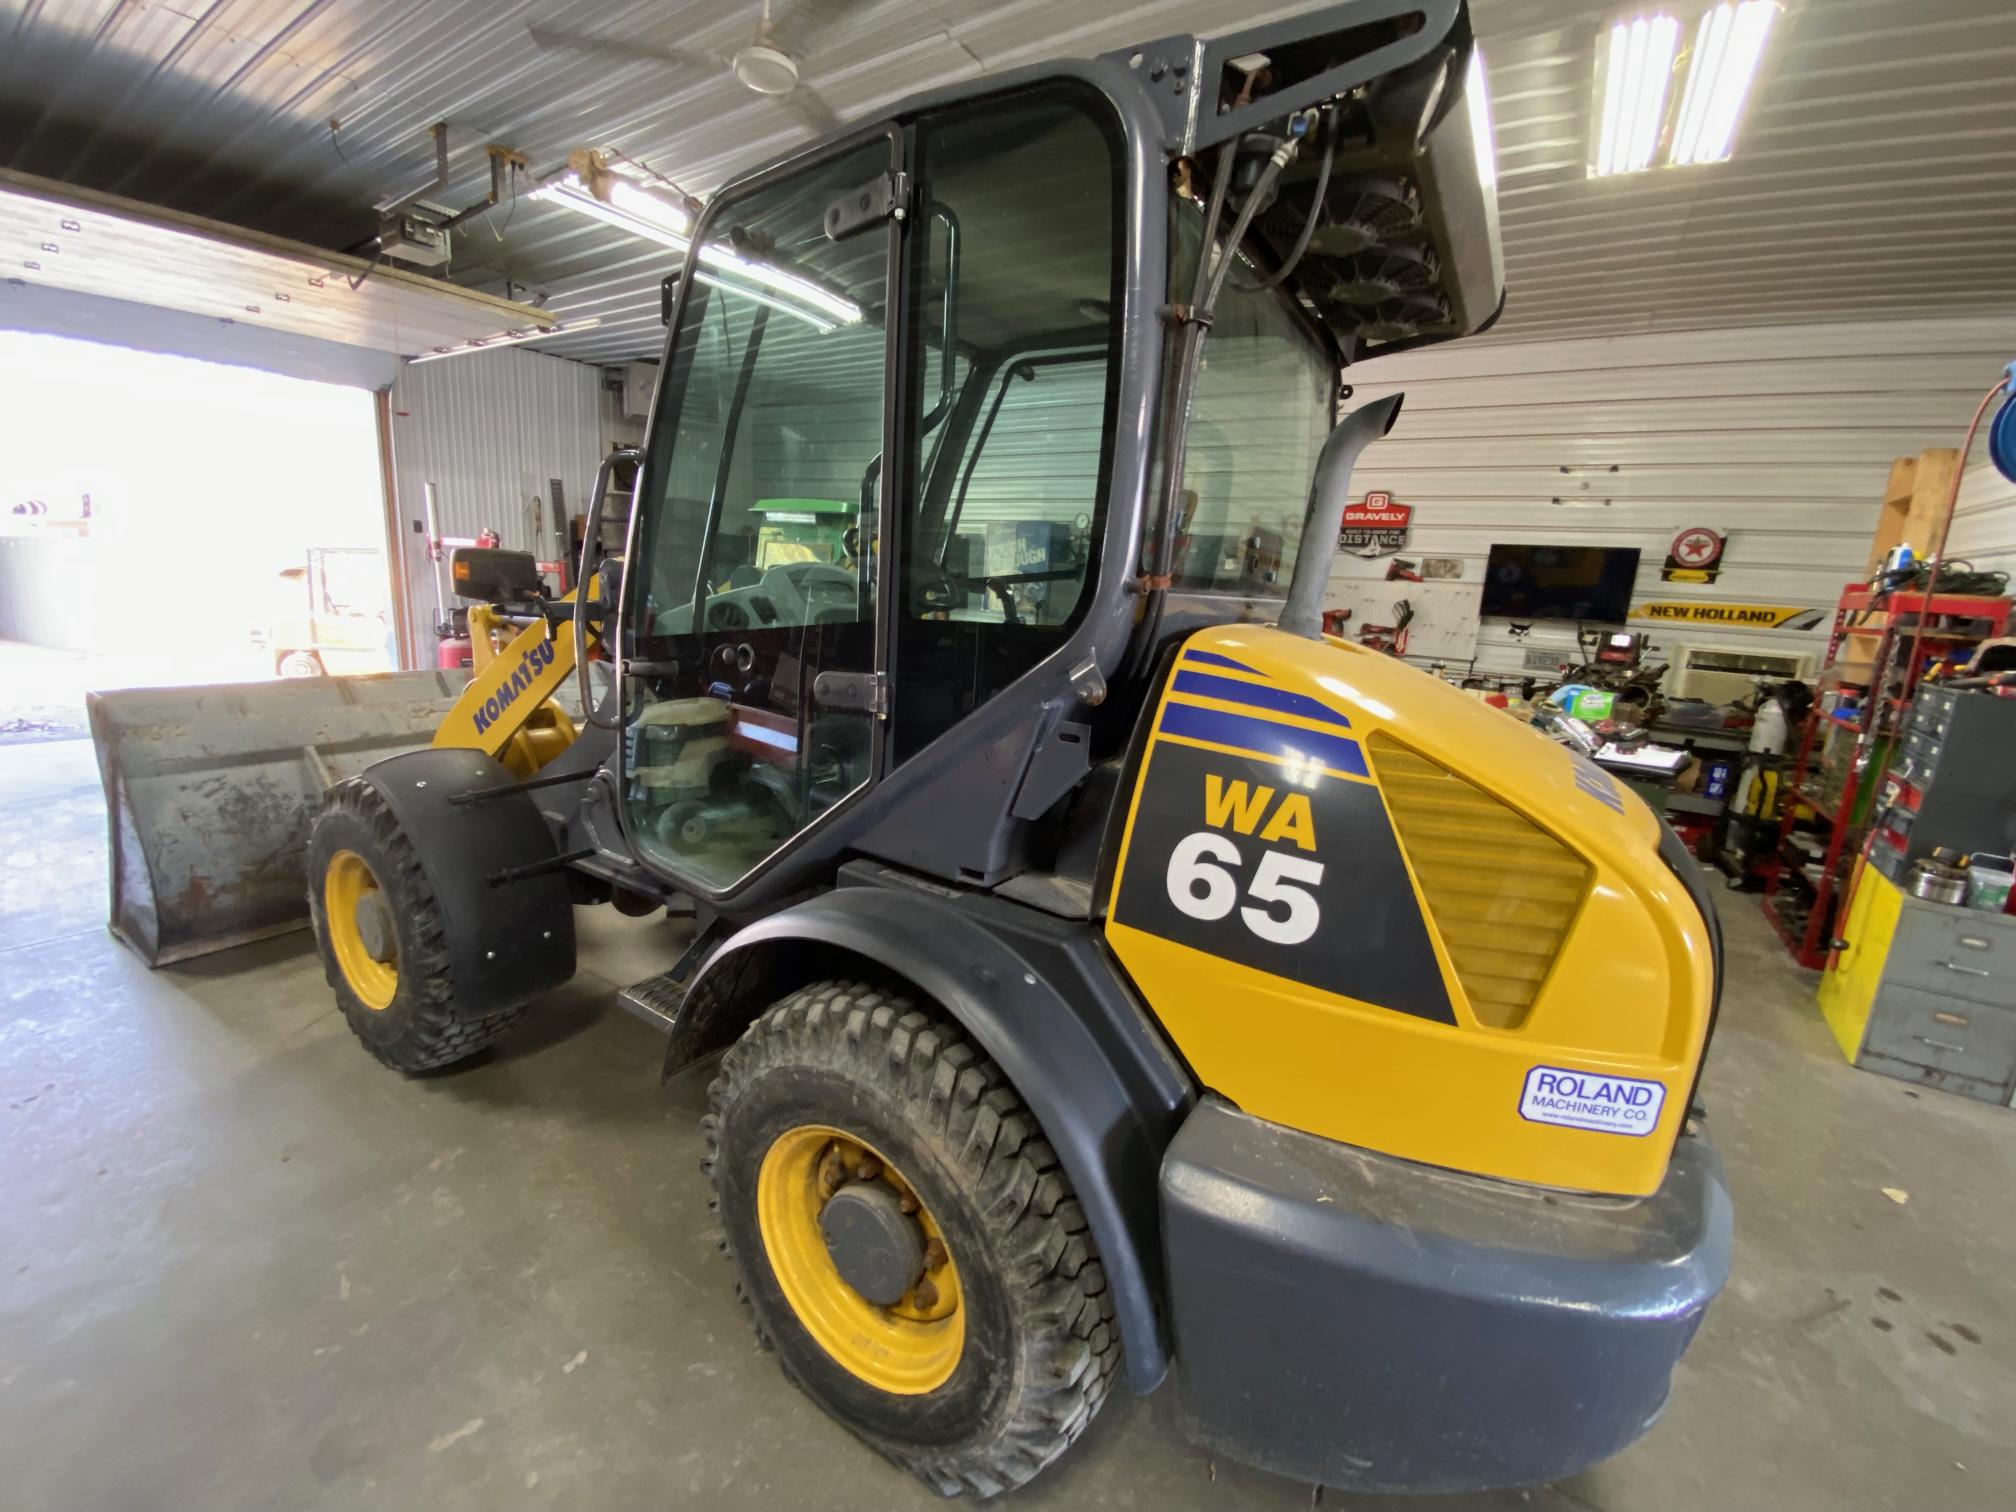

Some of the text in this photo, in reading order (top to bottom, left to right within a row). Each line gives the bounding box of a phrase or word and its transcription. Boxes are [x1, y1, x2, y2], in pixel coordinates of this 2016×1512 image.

[1345, 512, 1406, 521] GRAVELY
[1339, 534, 1406, 545] DISTANCE
[1650, 605, 1776, 623] NEW HOLLAND
[472, 638, 554, 735] KOMATSU
[1206, 774, 1316, 852] WA
[1167, 832, 1325, 945] 65
[1537, 1073, 1653, 1106] ROLAND
[1532, 1095, 1620, 1117] MACHINERY
